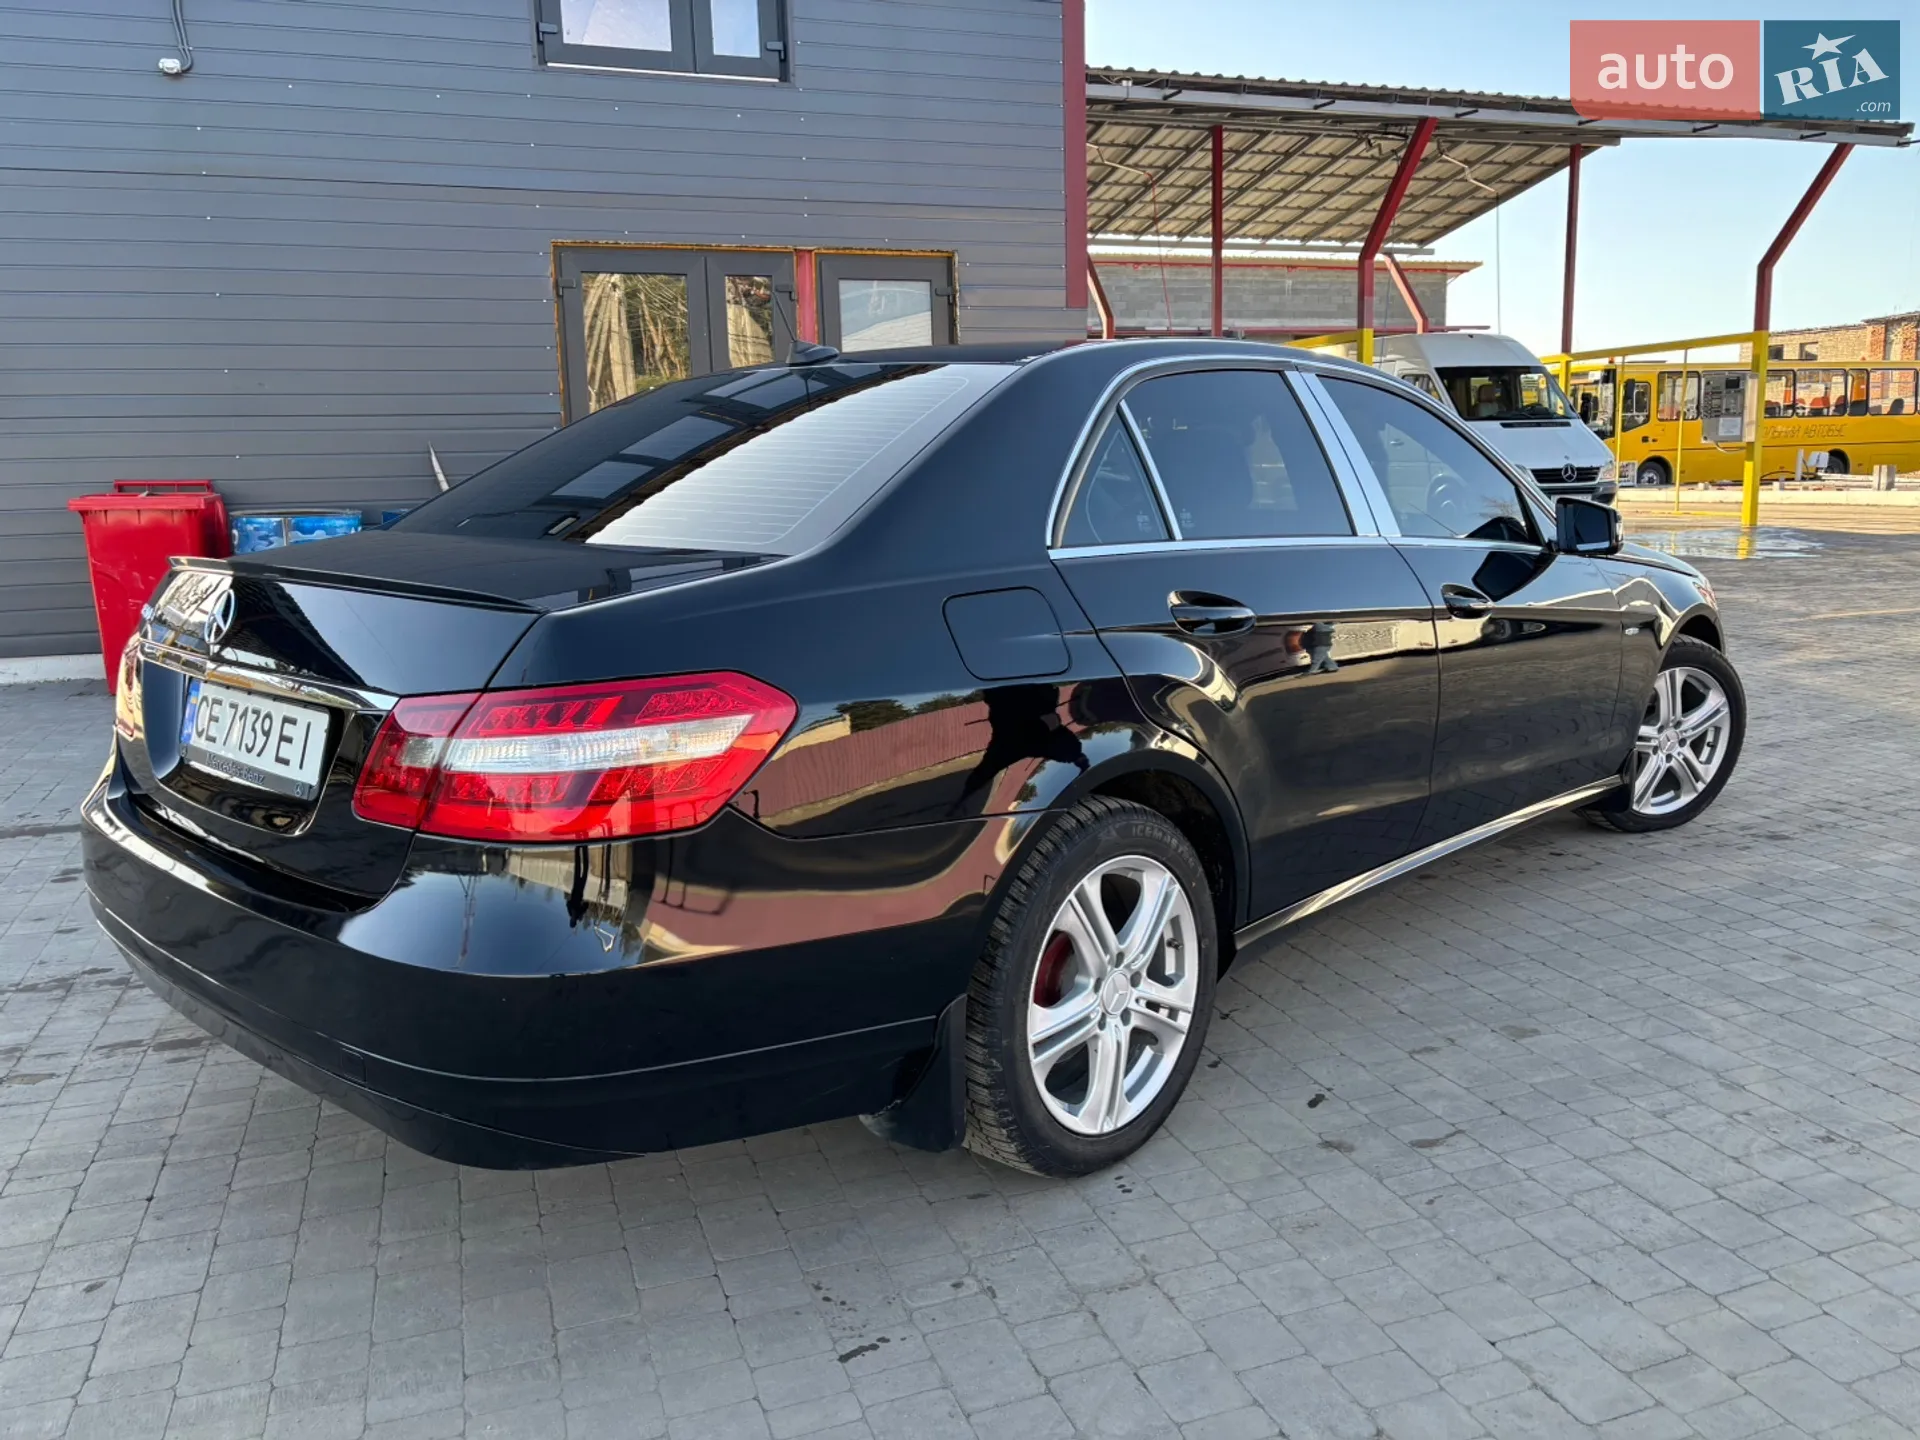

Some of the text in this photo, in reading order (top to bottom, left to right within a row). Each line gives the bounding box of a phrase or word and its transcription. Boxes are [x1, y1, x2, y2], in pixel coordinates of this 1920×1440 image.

[194, 695, 224, 744] CE
[222, 702, 274, 758] 7139
[274, 715, 312, 770] EI
